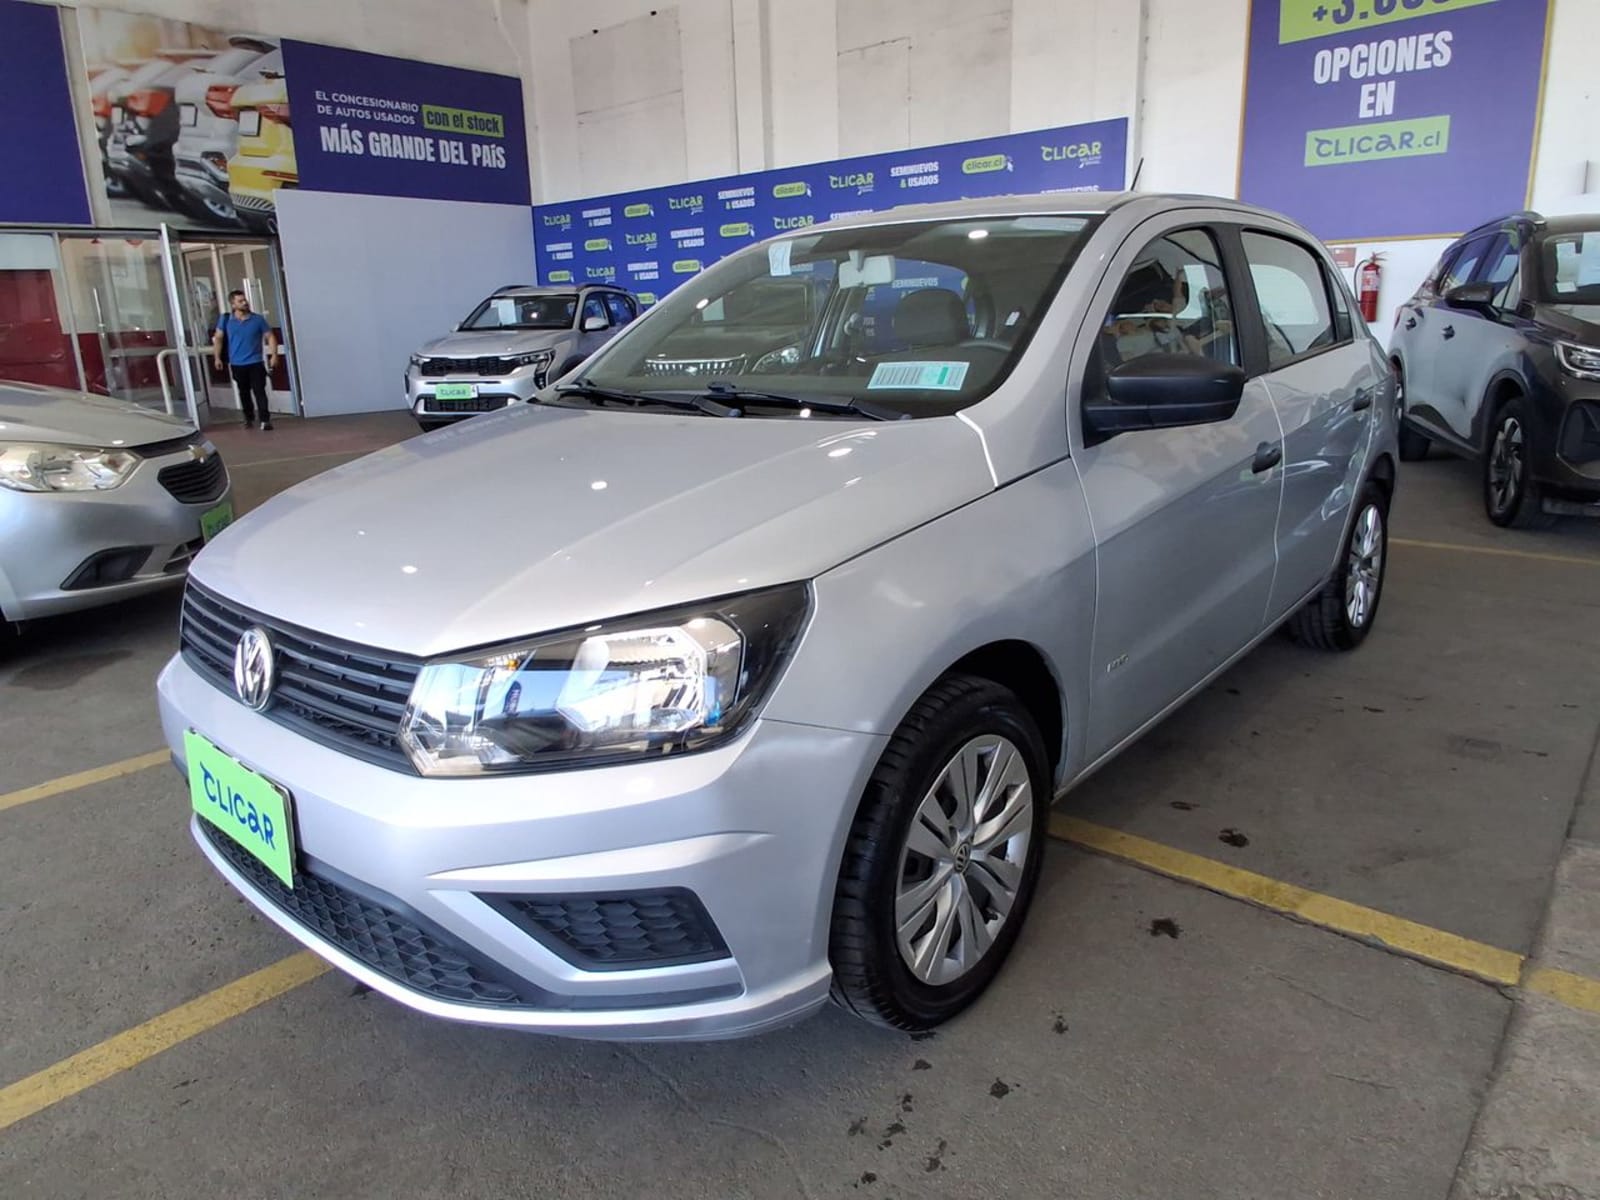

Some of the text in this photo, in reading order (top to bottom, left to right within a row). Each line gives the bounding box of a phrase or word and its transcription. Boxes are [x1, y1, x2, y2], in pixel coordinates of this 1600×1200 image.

[1313, 31, 1453, 84] OPCIONES
[315, 90, 419, 113] EL CONCESIONARIO
[1359, 80, 1396, 118] EN
[317, 104, 416, 125] DE AUTOS USADOS
[426, 110, 500, 133] con el stock
[320, 123, 506, 169] MÁS GRANDE DEL PAÍS
[890, 161, 939, 177] SEMINUEVOS
[965, 157, 1003, 172] clicar.cl
[907, 175, 939, 187] USADOS
